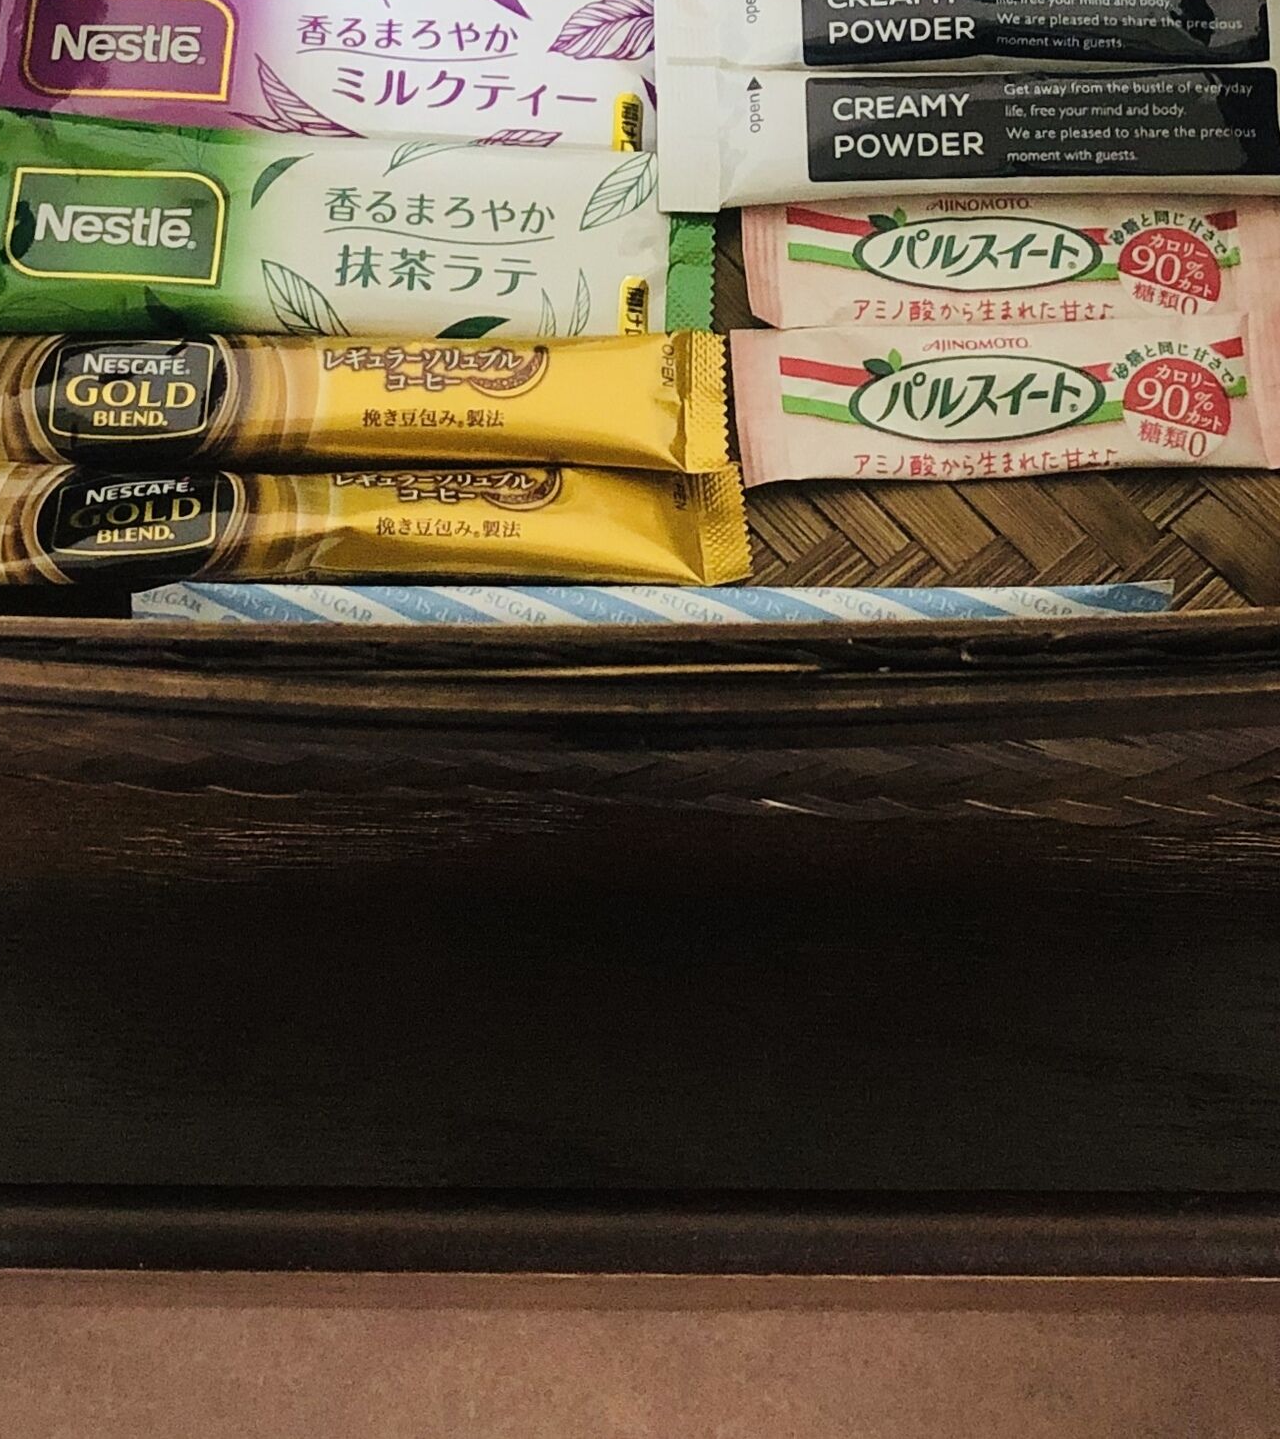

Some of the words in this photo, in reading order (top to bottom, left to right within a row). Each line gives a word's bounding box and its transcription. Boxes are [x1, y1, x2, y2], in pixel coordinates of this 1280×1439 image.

[297, 15, 518, 53] 香るまろやか
[829, 17, 975, 44] POWDER
[997, 13, 1020, 25] We
[1024, 15, 1046, 25] are
[1050, 13, 1099, 28] pleased
[1103, 16, 1118, 26] to
[1122, 15, 1157, 27] share
[1161, 17, 1182, 28] the
[1186, 18, 1243, 30] precious
[996, 36, 1049, 46] moment
[1053, 35, 1080, 47] with
[331, 67, 597, 117] ミルクティー
[1004, 83, 1029, 95] Get
[1034, 85, 1066, 97] away
[1071, 83, 1103, 94] from
[1107, 83, 1129, 94] the
[1133, 82, 1174, 93] bustle
[1177, 81, 1191, 93] of
[1195, 83, 1253, 97] everyday
[749, 93, 764, 133] open
[833, 93, 970, 121] CREAMY
[1005, 104, 1027, 118] life,
[1030, 104, 1056, 116] free
[1059, 107, 1088, 120] your
[1091, 103, 1122, 116] mind
[1126, 104, 1149, 116] and
[1153, 103, 1187, 118] body.
[835, 132, 984, 158] POWDER
[1005, 127, 1031, 139] We
[1034, 129, 1056, 139] are
[1060, 126, 1111, 142] pleased
[1115, 128, 1129, 139] to
[1134, 126, 1170, 138] share
[1174, 126, 1196, 138] the
[1200, 127, 1257, 141] precious
[1007, 150, 1060, 162] moment
[1064, 148, 1092, 161] with
[323, 187, 555, 234] 香るまろやか
[926, 198, 1030, 212] AJINOMOTO
[880, 229, 1079, 277] パルスイート
[1149, 233, 1208, 258] カロリー
[335, 244, 538, 296] 抹茶ラテ
[1130, 245, 1205, 285] 90%
[1178, 277, 1212, 297] カット
[923, 338, 1029, 352] AJINOMOTO
[324, 347, 522, 371] レギュラーソリュブル
[661, 344, 675, 387] OPEN
[387, 373, 462, 391] コーヒー
[1155, 364, 1217, 388] カロリー
[66, 374, 197, 408] GOLD
[876, 371, 1081, 428] パルスイート
[1136, 377, 1214, 420] 90%
[1185, 410, 1222, 431] カット
[334, 471, 535, 490] レギュラーソリュブル
[398, 488, 476, 503] コーヒー
[69, 497, 202, 529] GOLD
